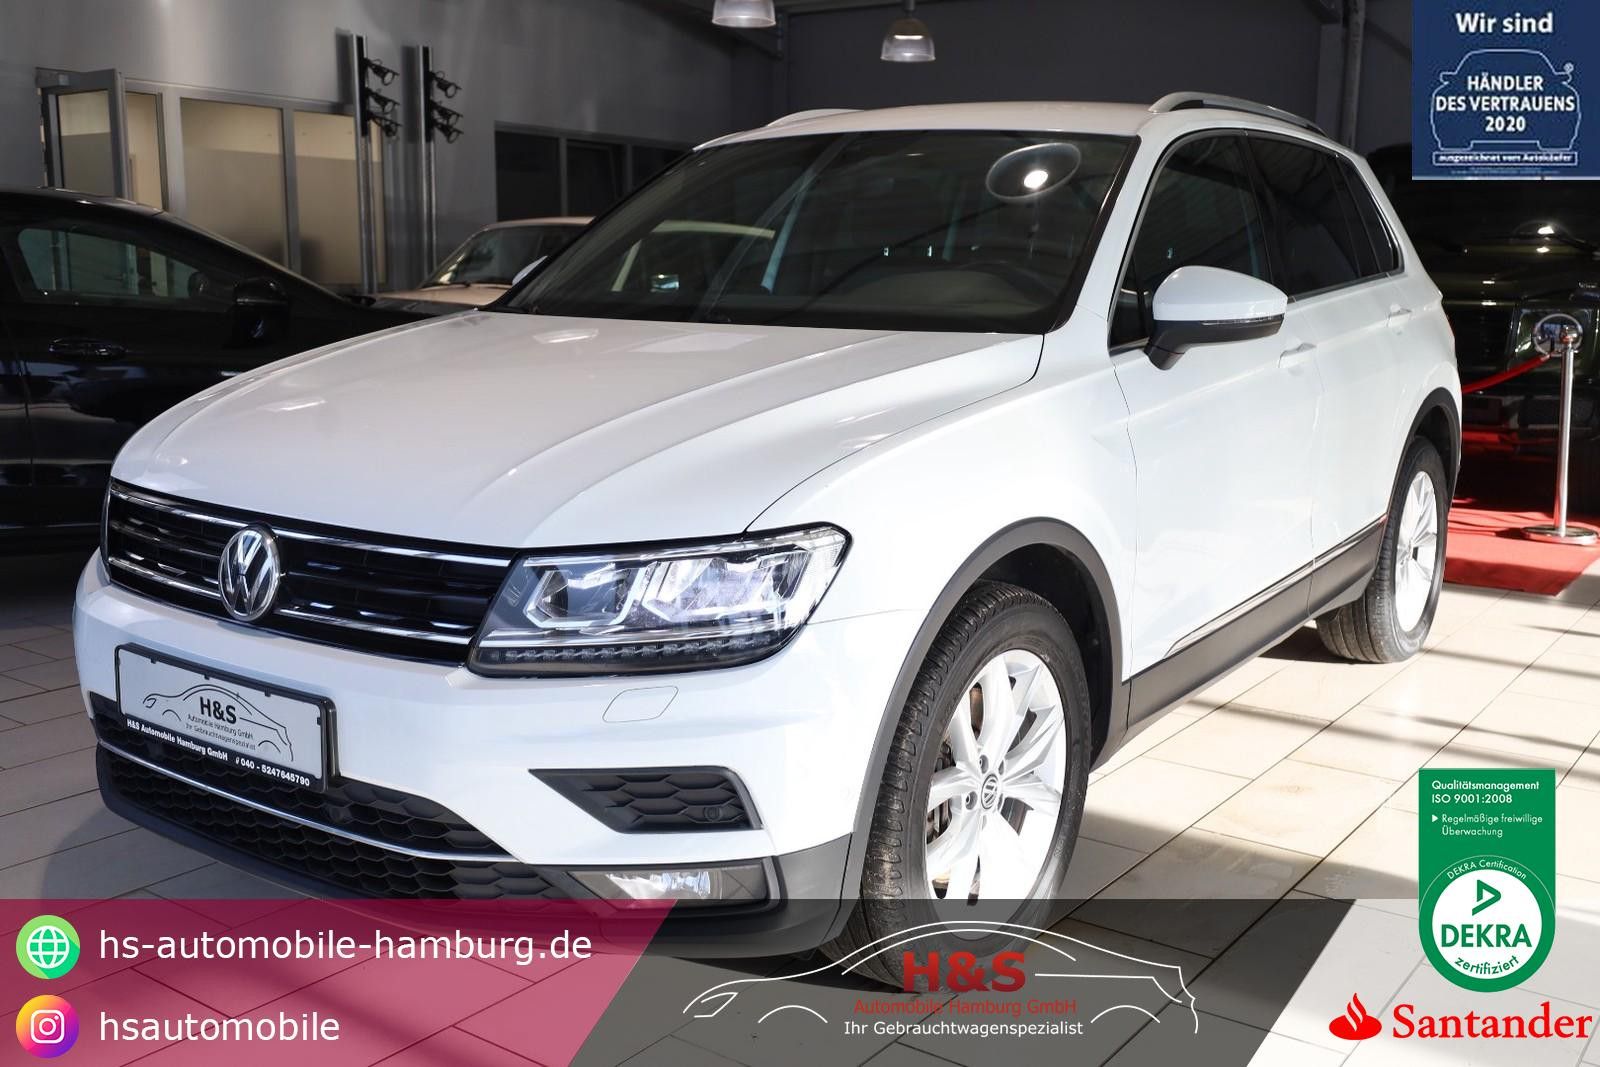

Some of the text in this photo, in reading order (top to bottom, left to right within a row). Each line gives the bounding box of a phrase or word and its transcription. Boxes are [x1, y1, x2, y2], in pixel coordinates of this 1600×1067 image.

[200, 696, 237, 725] H&S
[127, 719, 140, 730] H&S
[141, 724, 176, 743] Automobile
[176, 735, 206, 755] Hamburg
[207, 747, 228, 761] GmbH
[240, 758, 255, 769] 040
